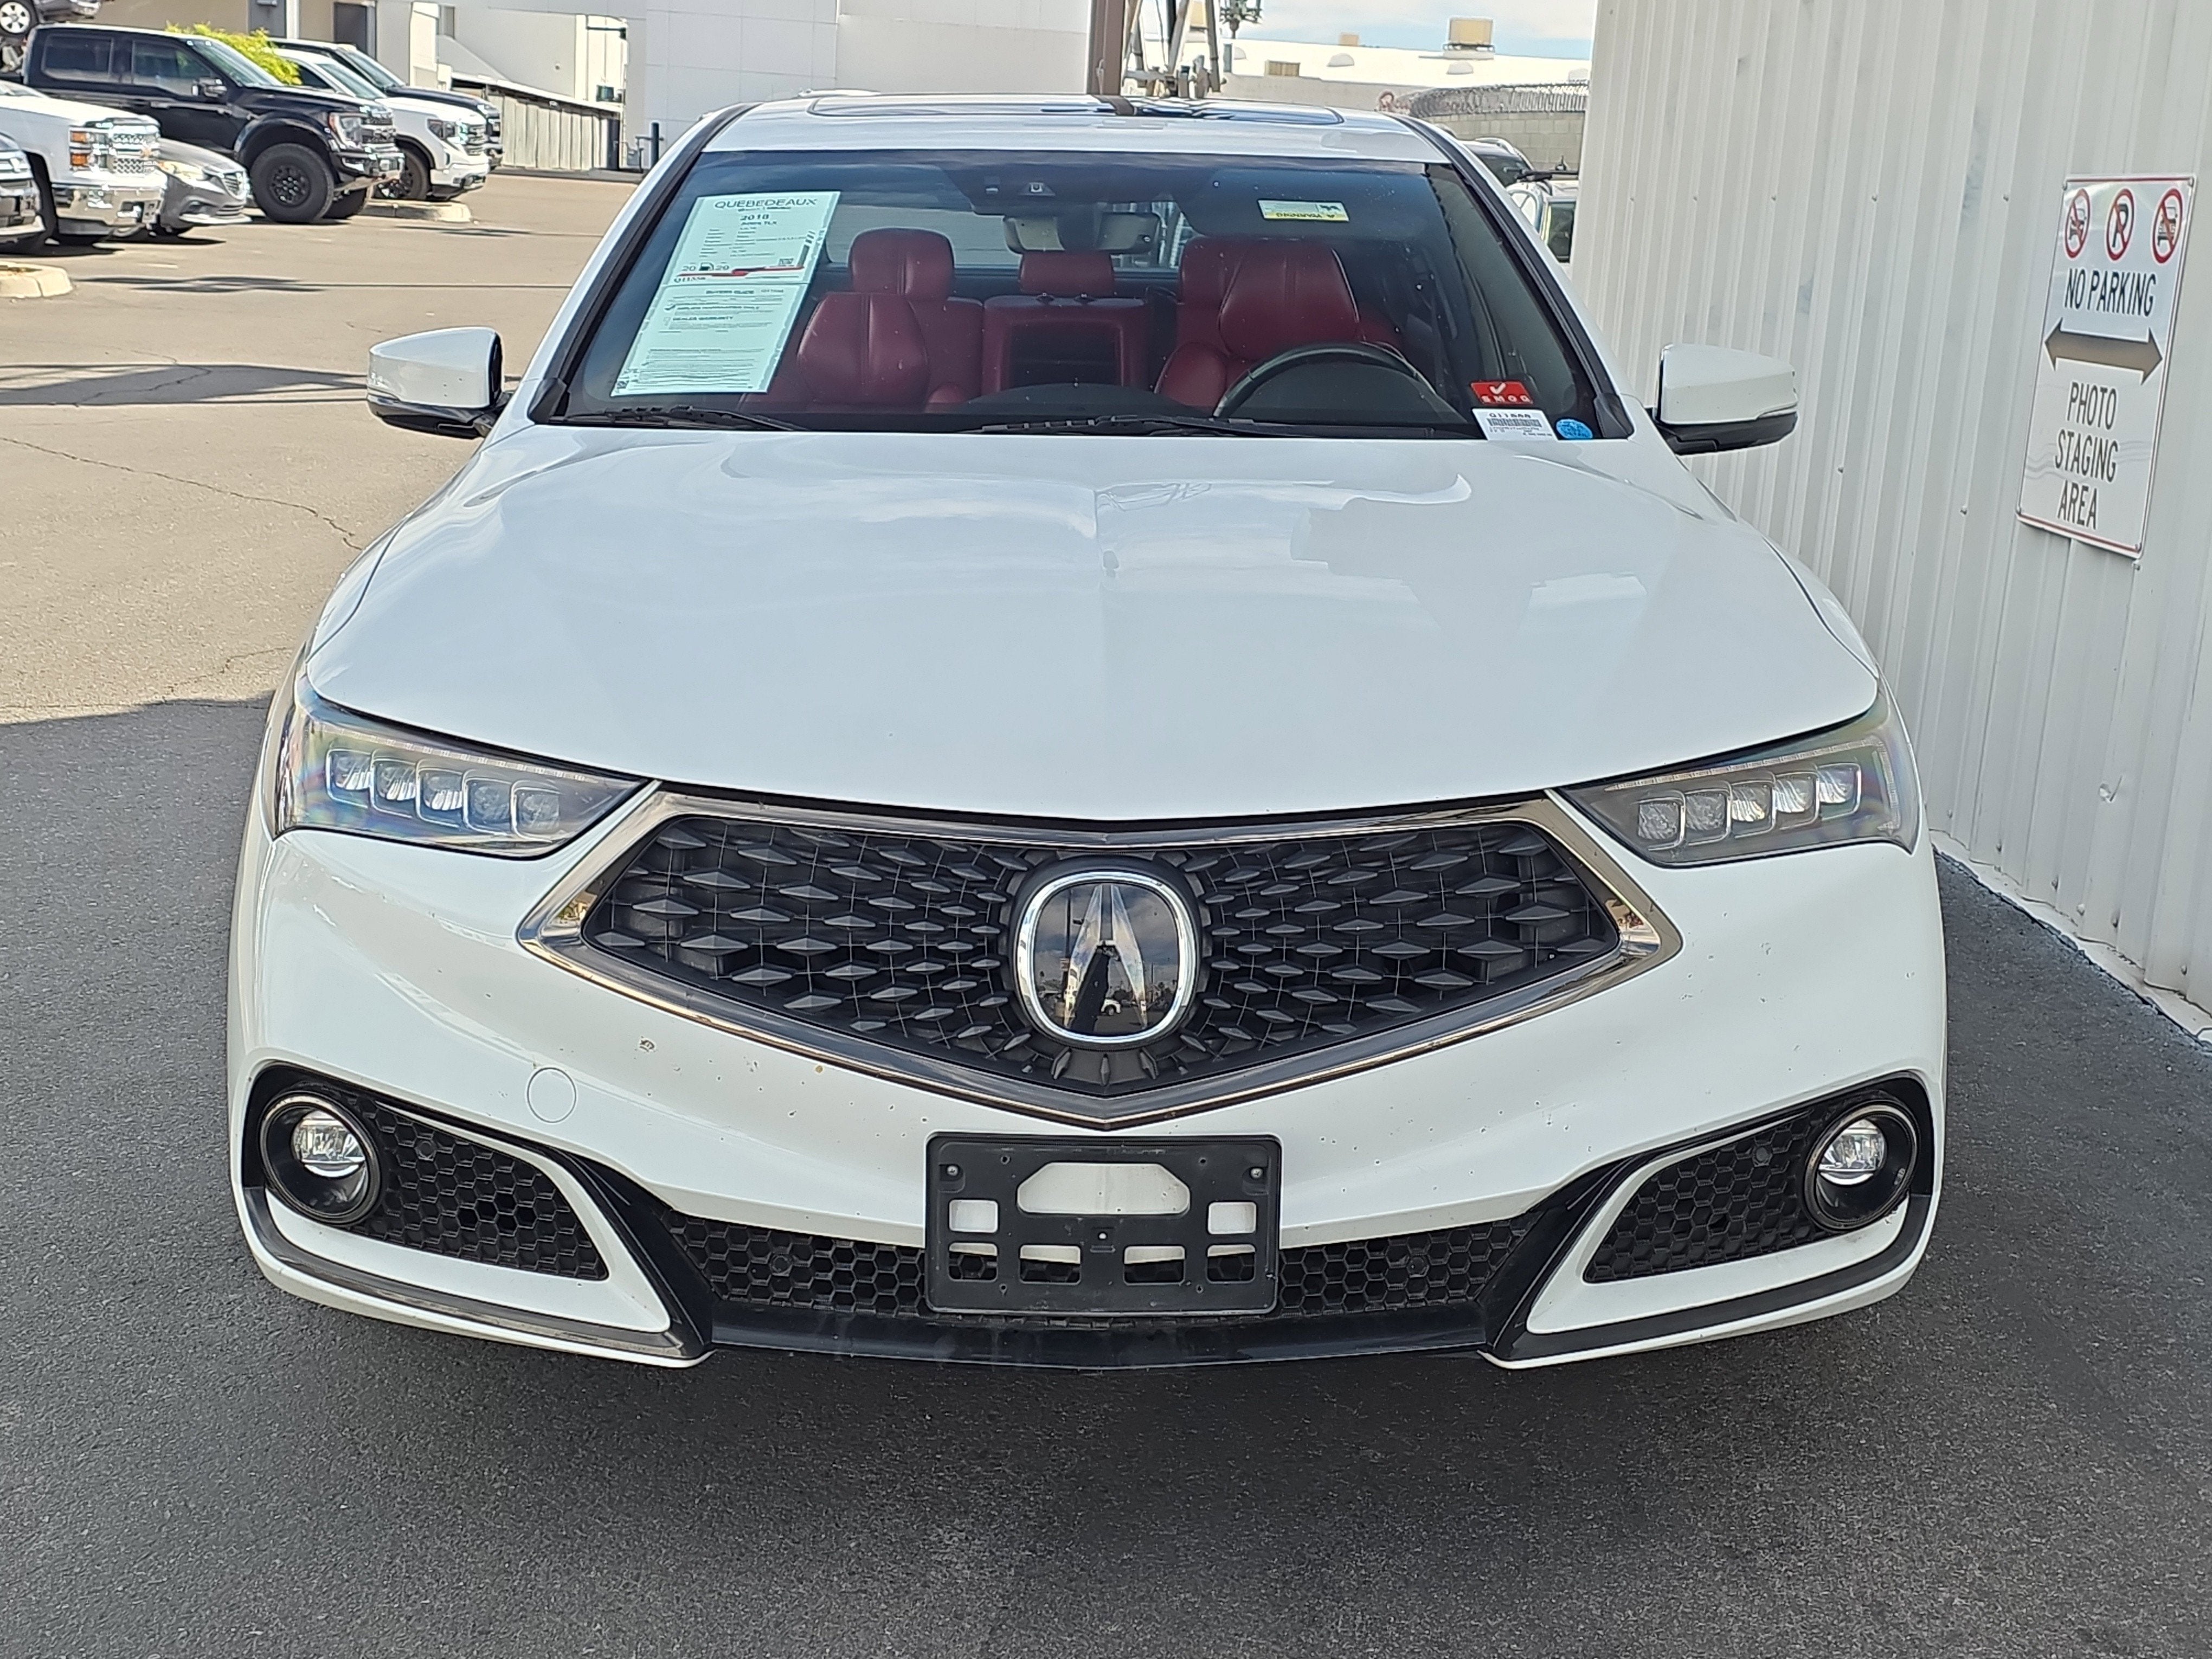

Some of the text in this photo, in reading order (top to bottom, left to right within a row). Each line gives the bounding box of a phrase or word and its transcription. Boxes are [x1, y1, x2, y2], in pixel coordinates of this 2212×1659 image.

[715, 198, 817, 209] QUEBEDEAUX
[2064, 268, 2157, 317] NO PARKING
[2067, 381, 2117, 430] PHOTO
[2055, 428, 2118, 483] STAGING
[2057, 479, 2098, 530] AREA
